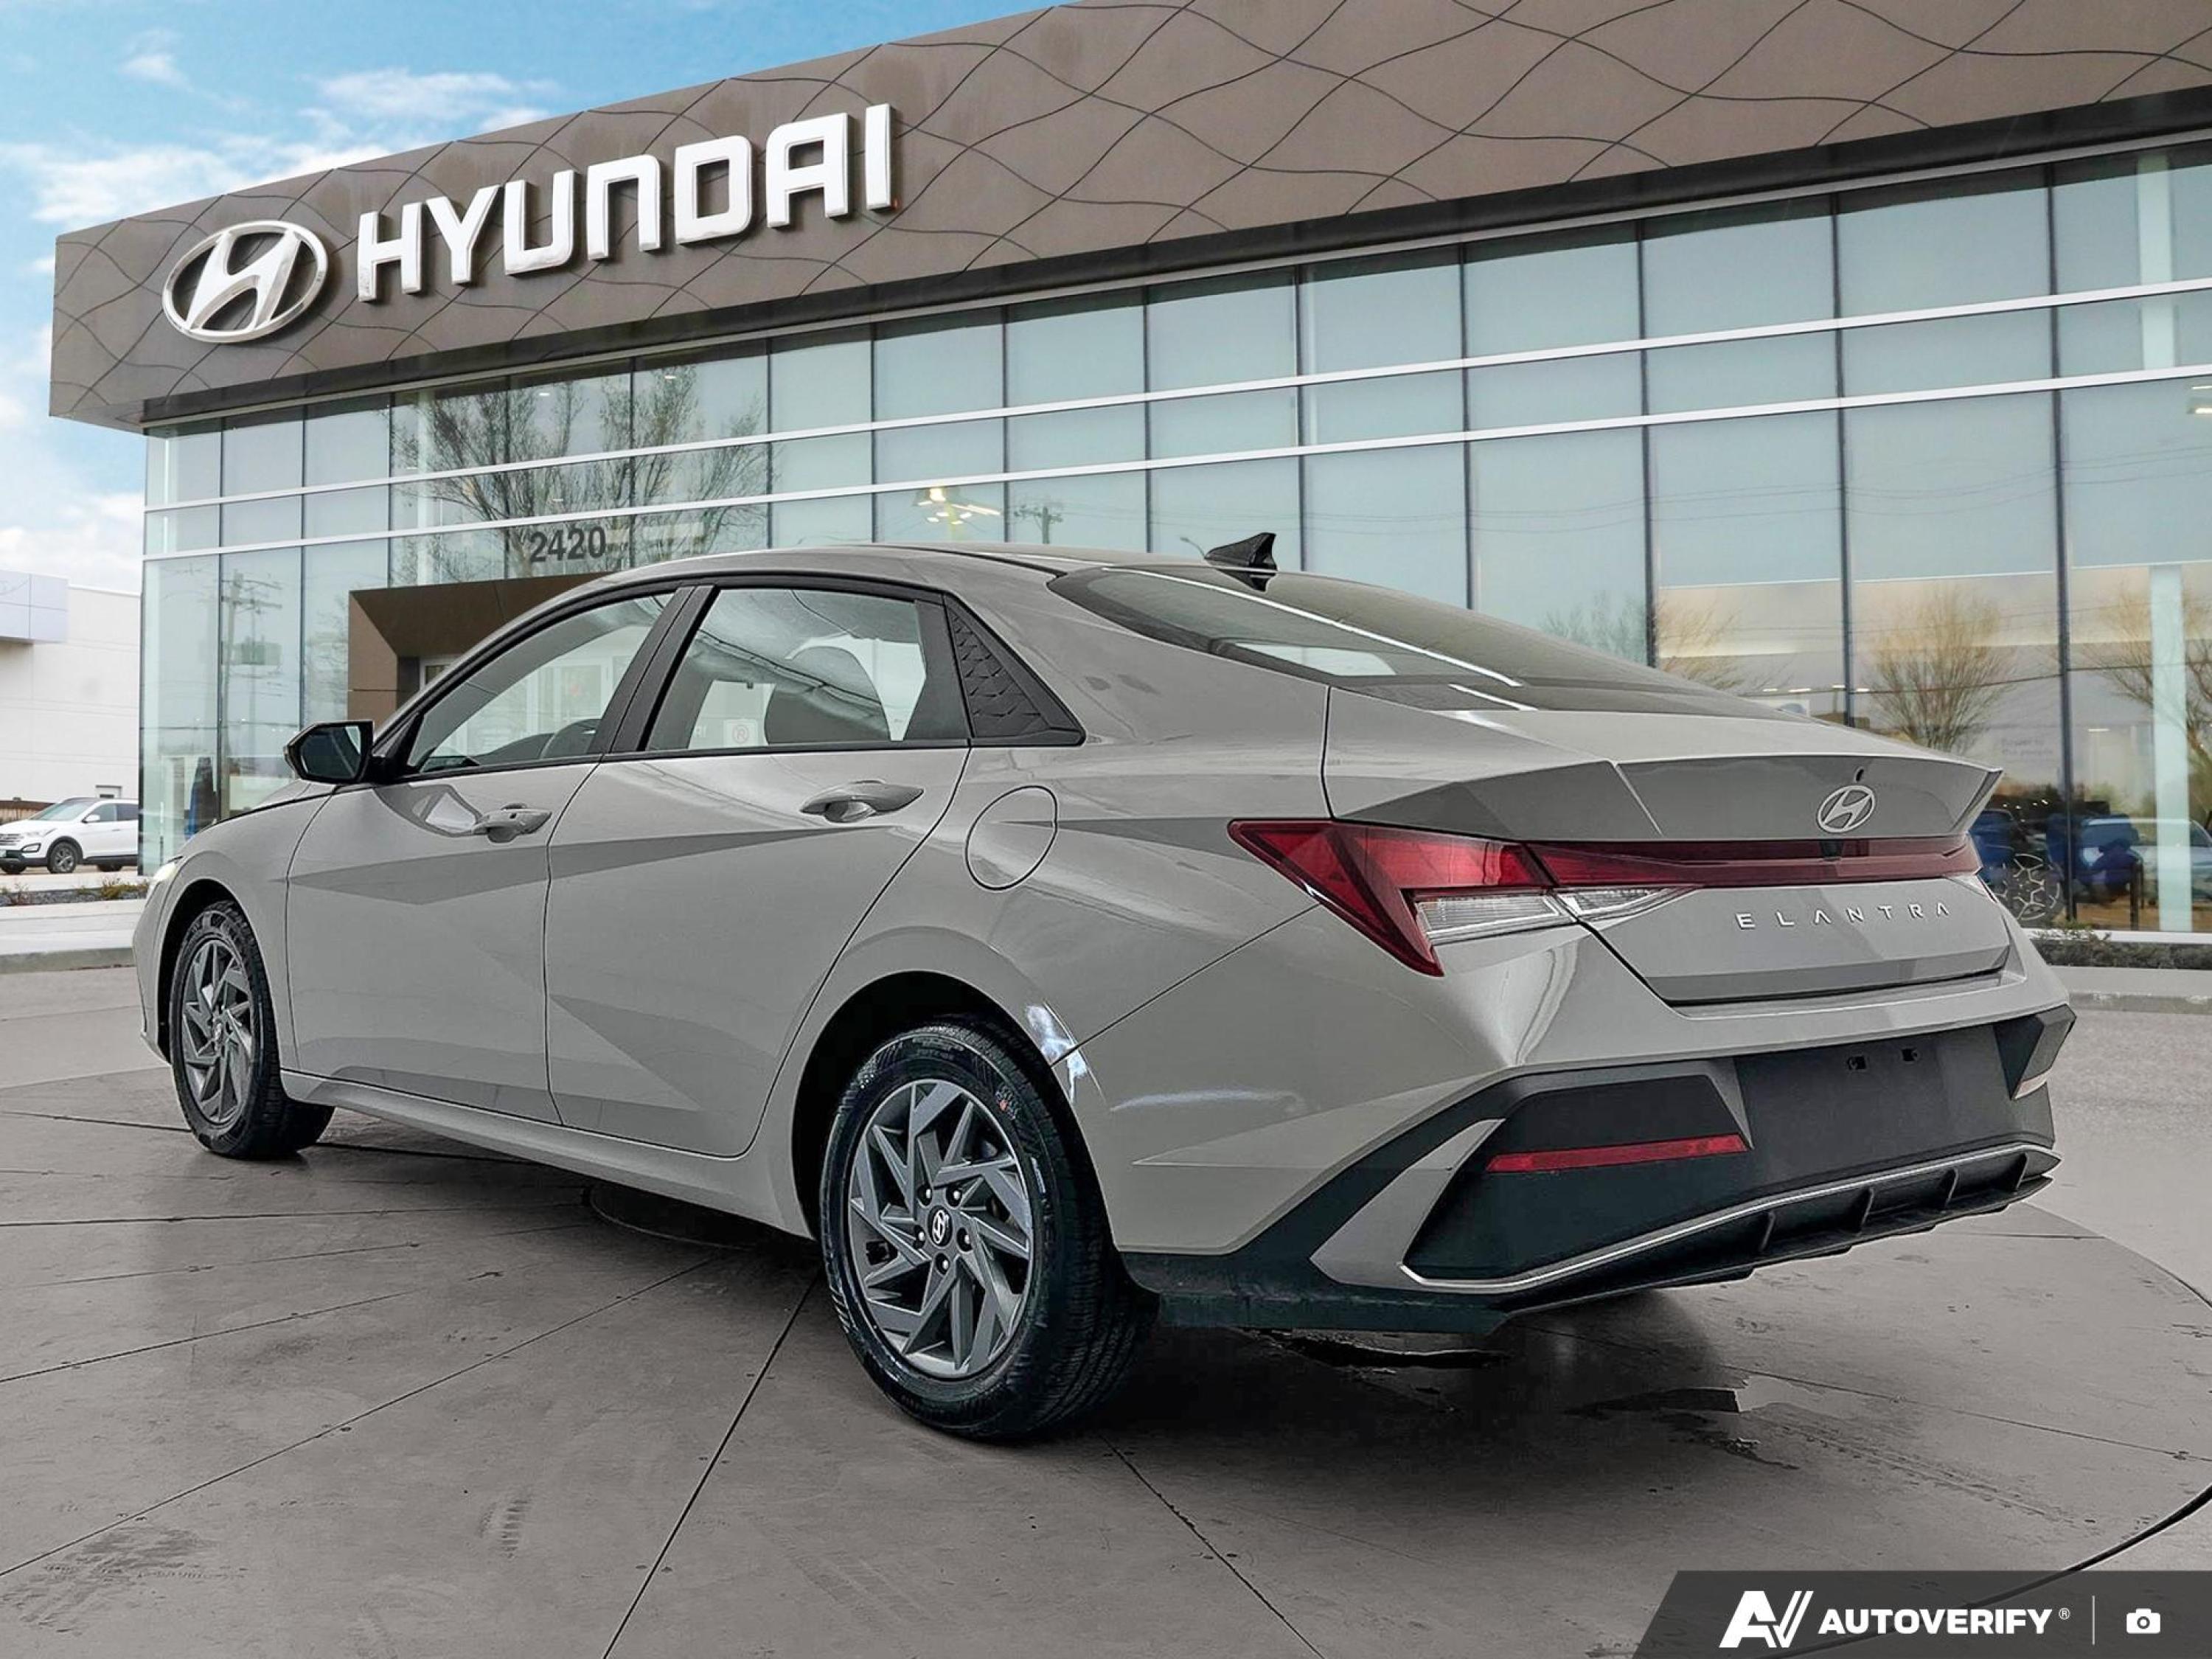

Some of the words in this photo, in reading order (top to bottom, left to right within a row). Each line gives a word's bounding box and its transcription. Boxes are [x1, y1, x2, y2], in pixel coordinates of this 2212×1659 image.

[357, 103, 893, 302] HYUNDAI
[529, 526, 606, 562] 2420
[1736, 902, 1950, 929] ELANTRA
